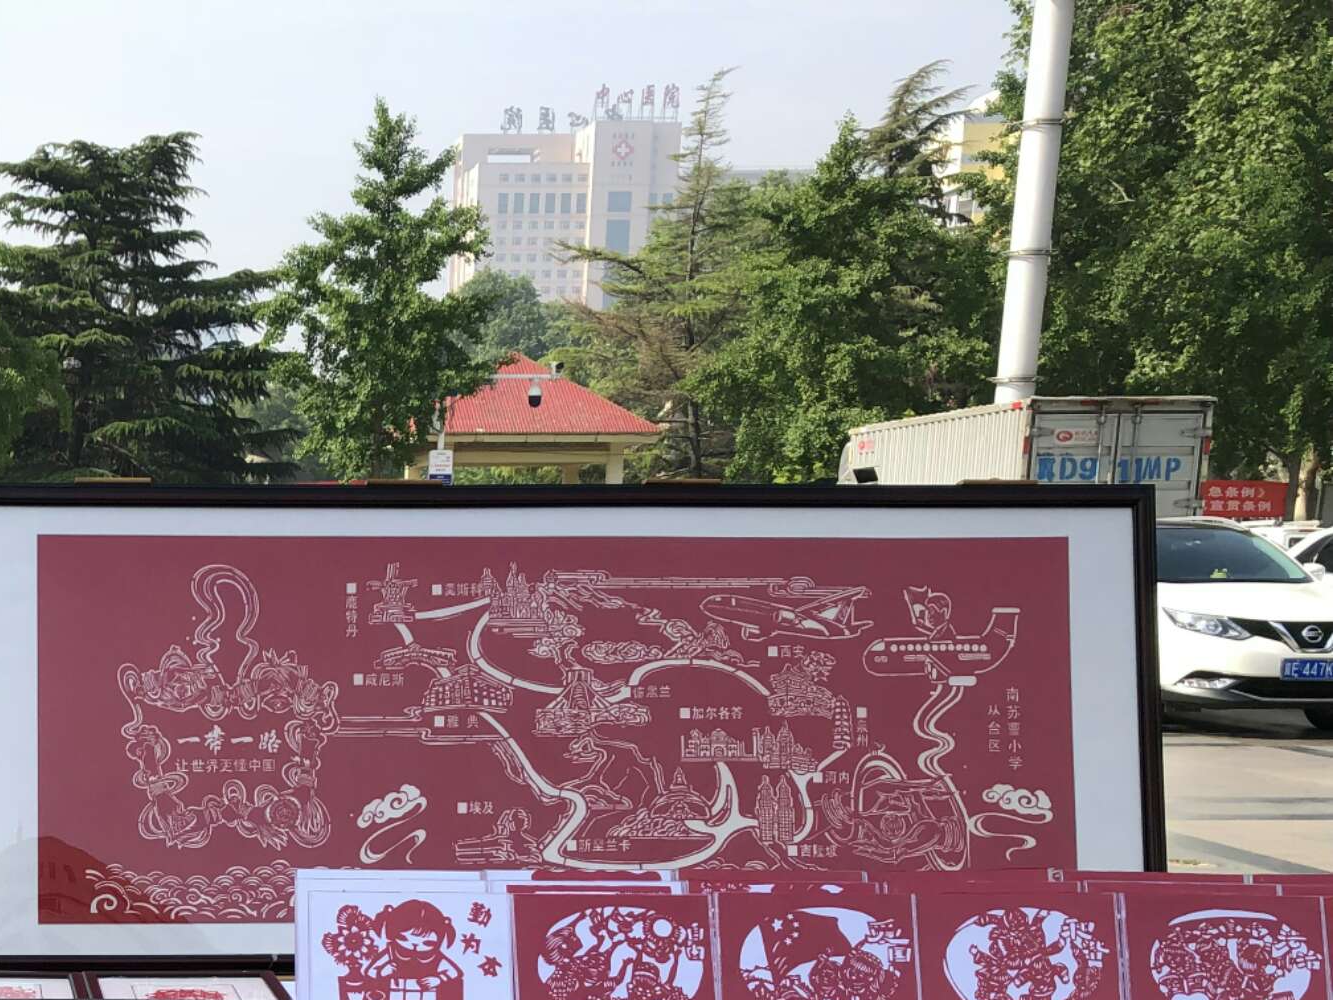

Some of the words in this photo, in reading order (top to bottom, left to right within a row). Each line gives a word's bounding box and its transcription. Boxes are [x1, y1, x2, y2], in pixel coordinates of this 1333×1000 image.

[366, 673, 405, 687] 威尼斯
[692, 706, 743, 720] 加尔各答
[177, 724, 282, 755] 一带一路
[469, 801, 494, 815] 埃及
[460, 901, 503, 977] 勤为本
